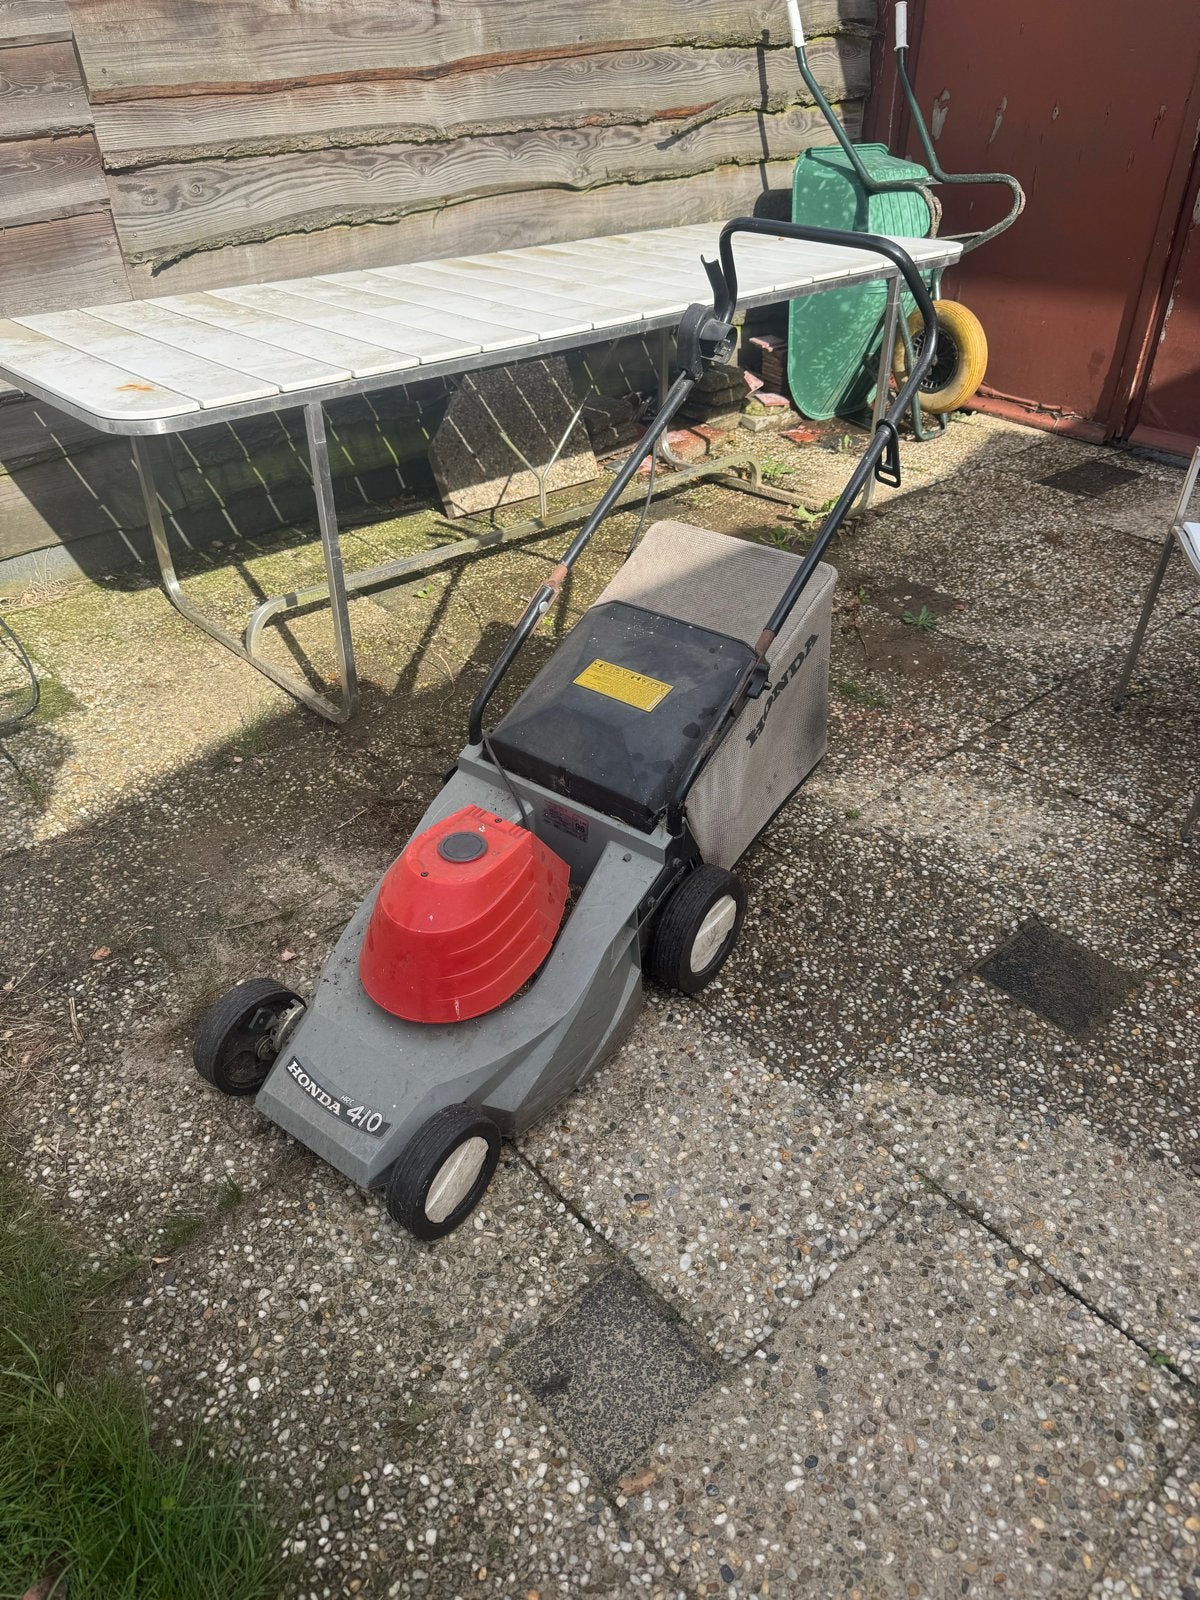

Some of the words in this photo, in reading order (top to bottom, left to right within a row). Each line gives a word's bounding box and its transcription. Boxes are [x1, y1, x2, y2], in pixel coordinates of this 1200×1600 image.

[745, 633, 819, 748] HONDA
[287, 1060, 341, 1116] HONDA
[346, 1105, 383, 1132] 410
